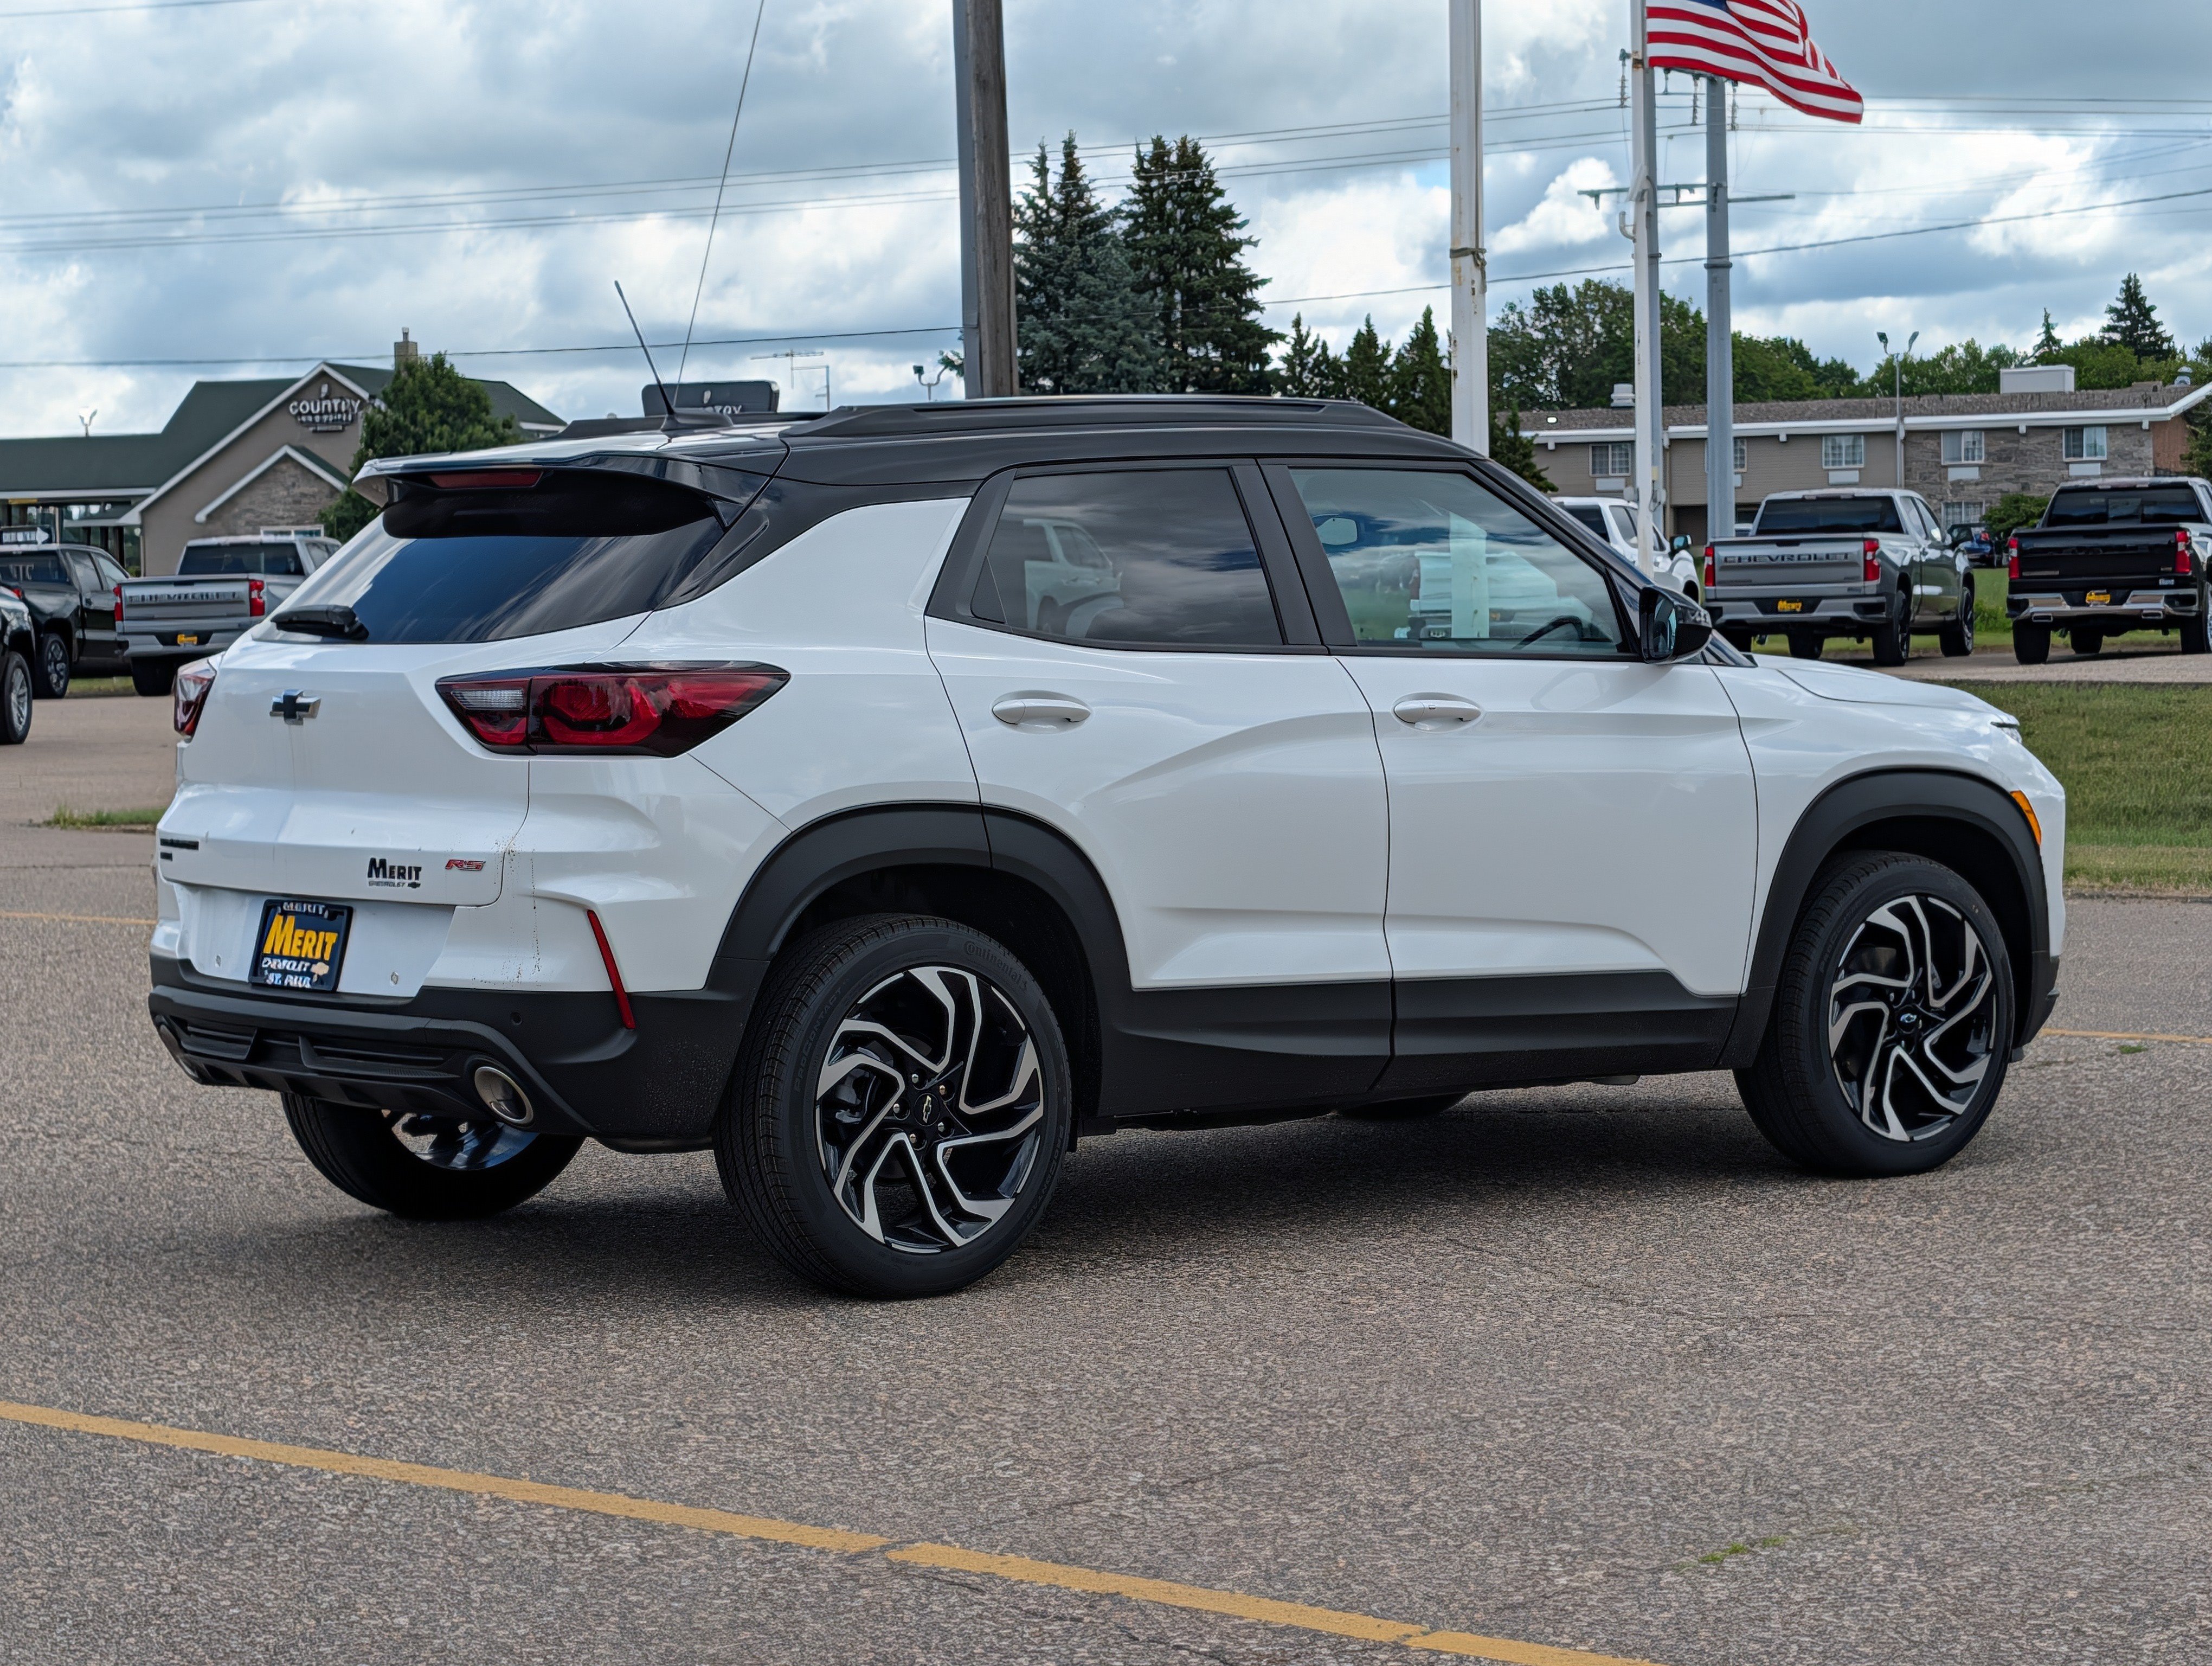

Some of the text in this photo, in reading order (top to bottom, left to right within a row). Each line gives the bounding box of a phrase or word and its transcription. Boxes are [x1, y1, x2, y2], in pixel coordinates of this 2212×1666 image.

[1724, 553, 1849, 564] CHEVROLET
[368, 857, 422, 881] MERIT
[445, 859, 486, 872] RS
[263, 913, 338, 961] MERIT
